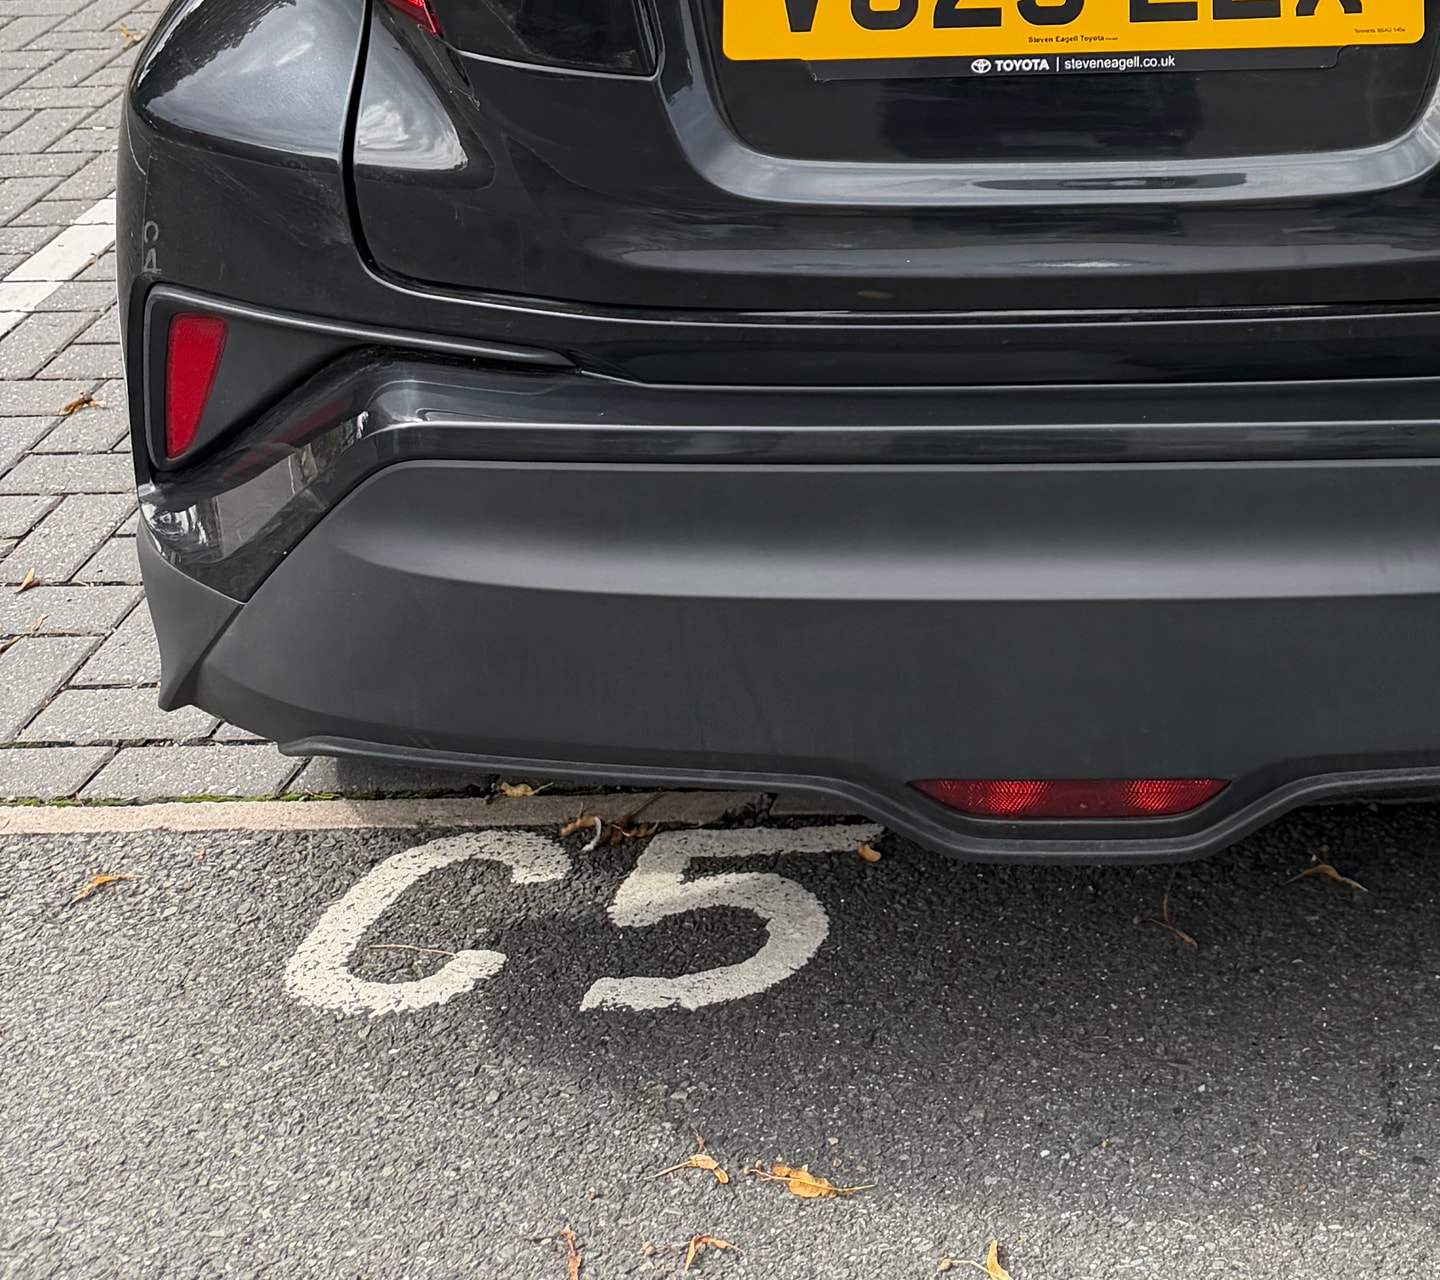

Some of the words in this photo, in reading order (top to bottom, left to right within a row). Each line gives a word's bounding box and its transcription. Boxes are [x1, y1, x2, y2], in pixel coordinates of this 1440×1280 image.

[1080, 35, 1105, 43] Toyota
[994, 58, 1050, 72] TOYOTA
[1064, 55, 1176, 71] steveneagell.co.uk
[284, 824, 884, 1017] C5
